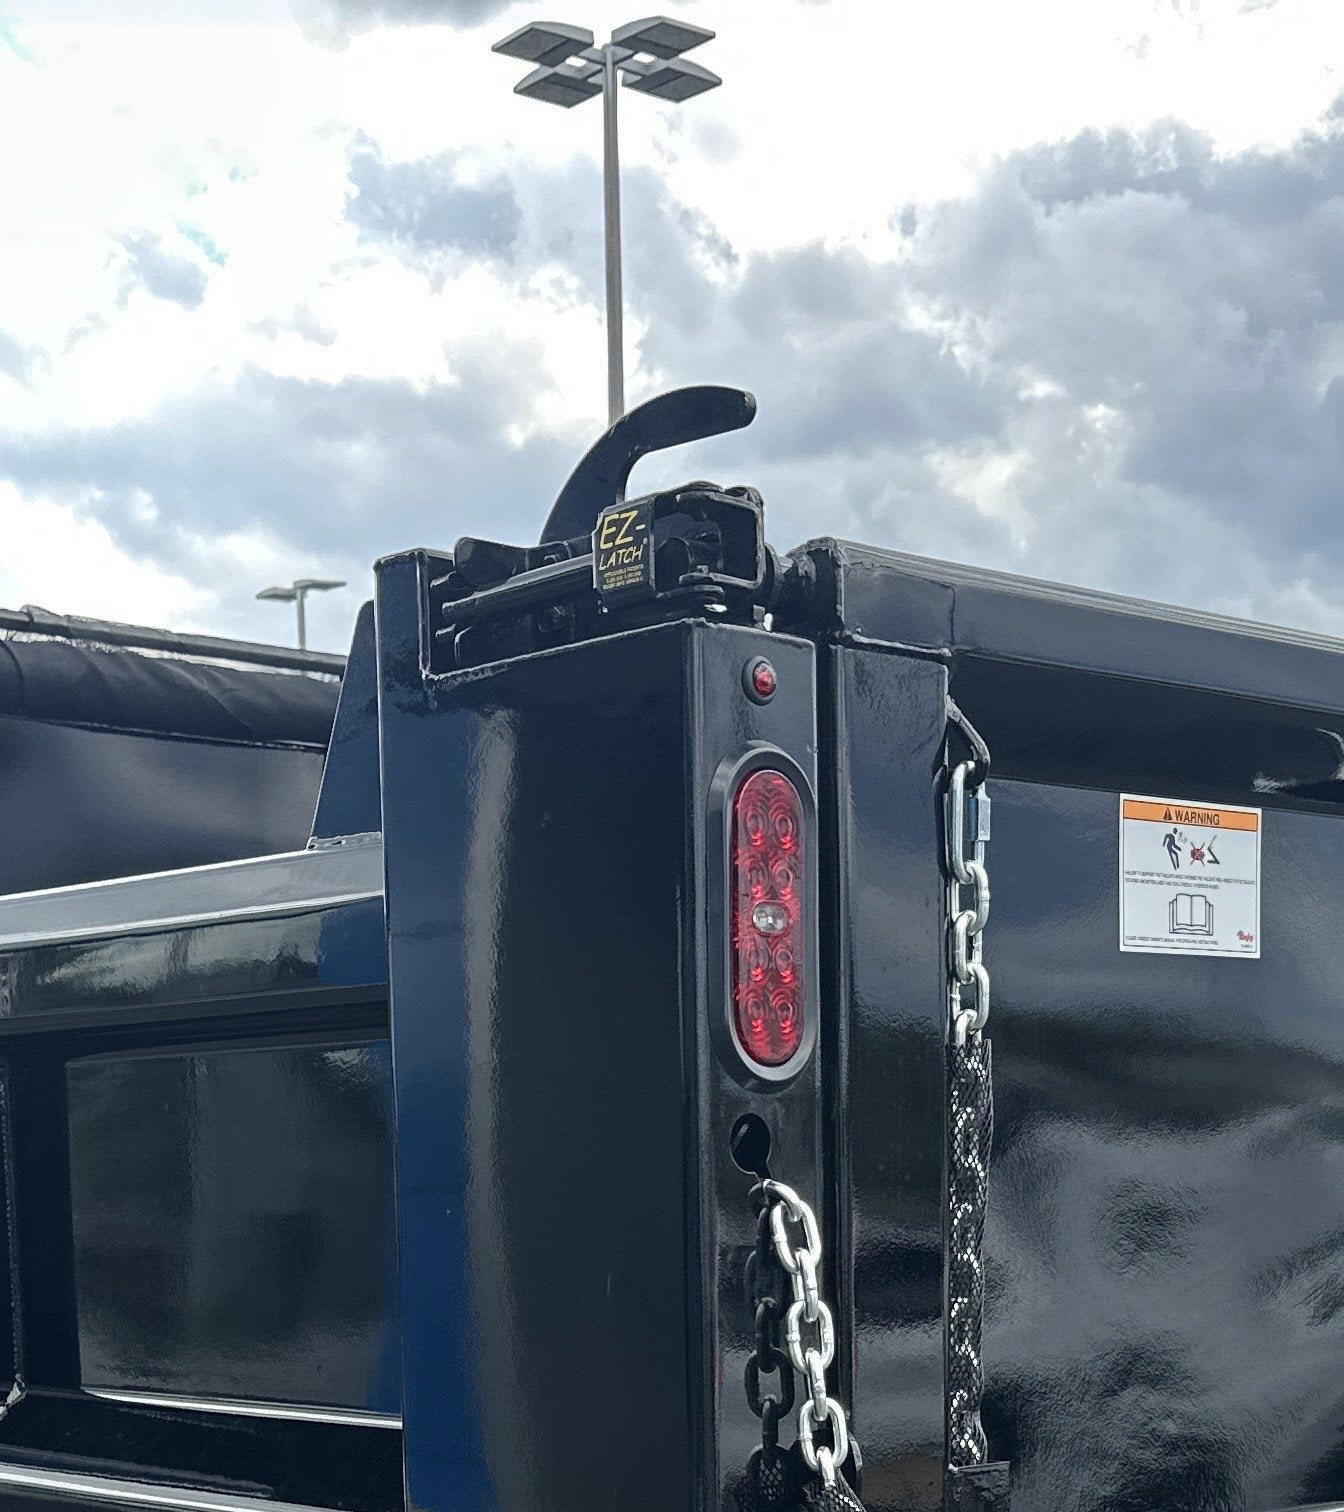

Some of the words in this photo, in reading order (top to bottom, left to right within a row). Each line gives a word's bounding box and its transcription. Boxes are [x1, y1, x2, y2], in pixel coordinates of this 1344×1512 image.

[599, 510, 646, 550] EZ-
[599, 544, 644, 571] LATCH
[1174, 809, 1220, 826] WARNING
